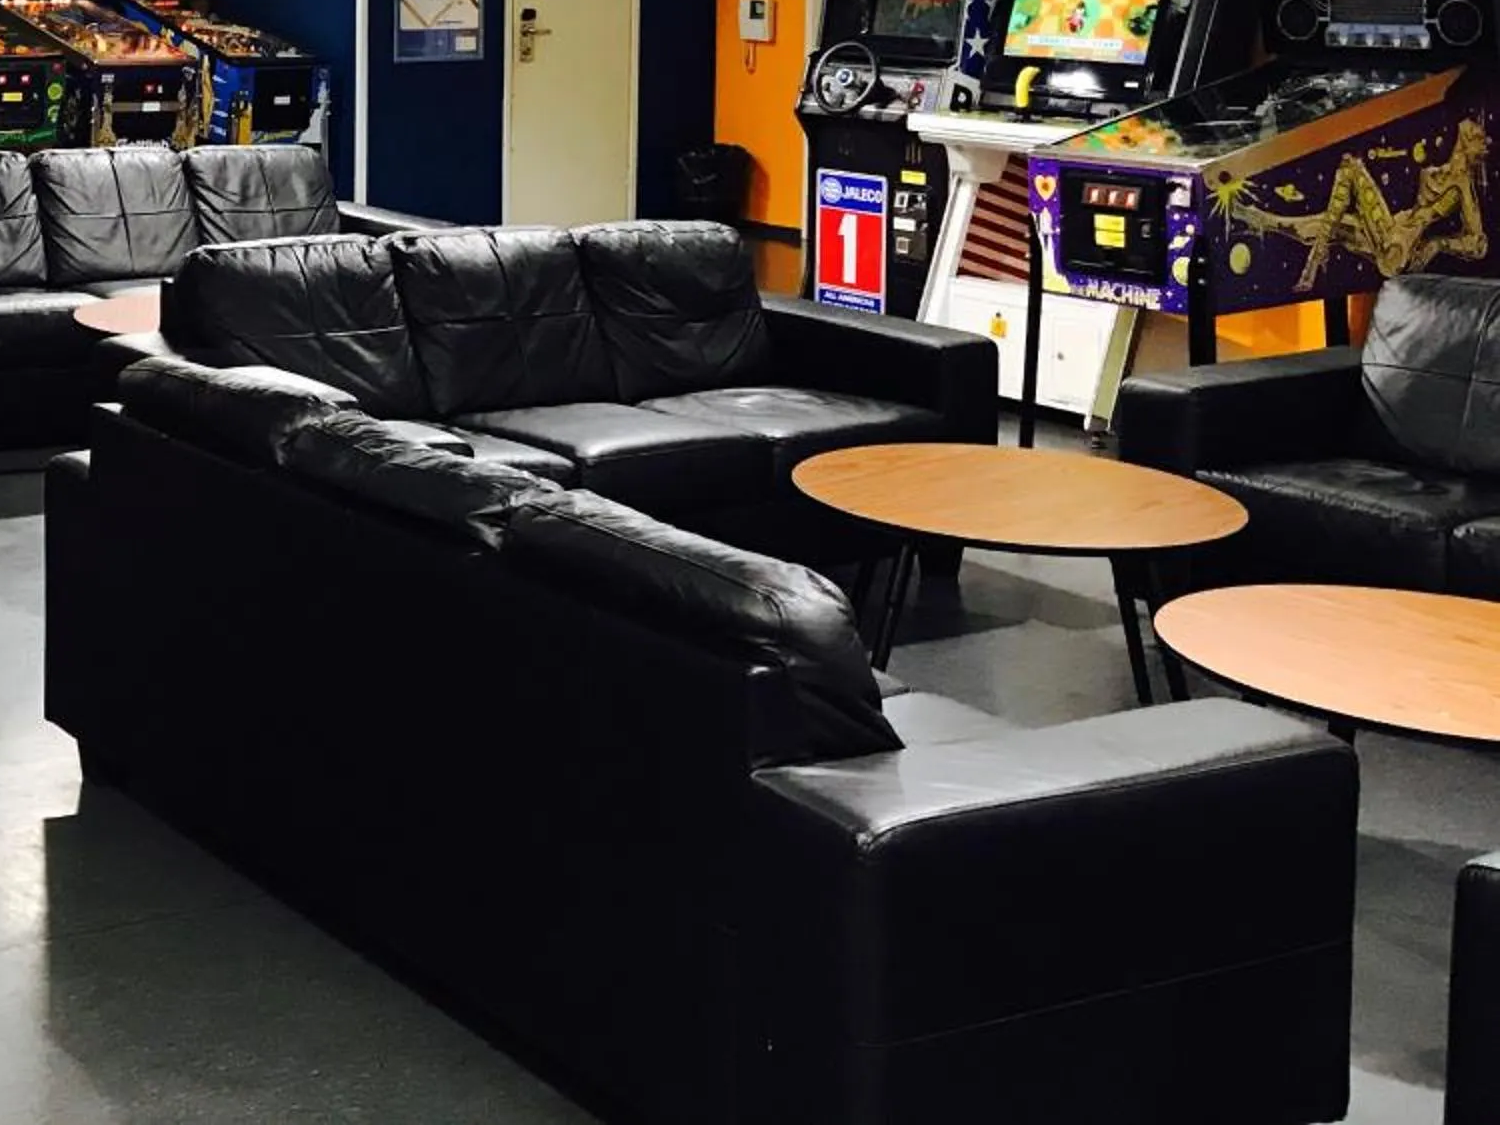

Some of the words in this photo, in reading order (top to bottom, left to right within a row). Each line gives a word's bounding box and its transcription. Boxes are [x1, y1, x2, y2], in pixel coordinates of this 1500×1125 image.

[843, 186, 883, 203] JALECO
[837, 213, 858, 285] 1
[1086, 278, 1162, 310] MACHINE
